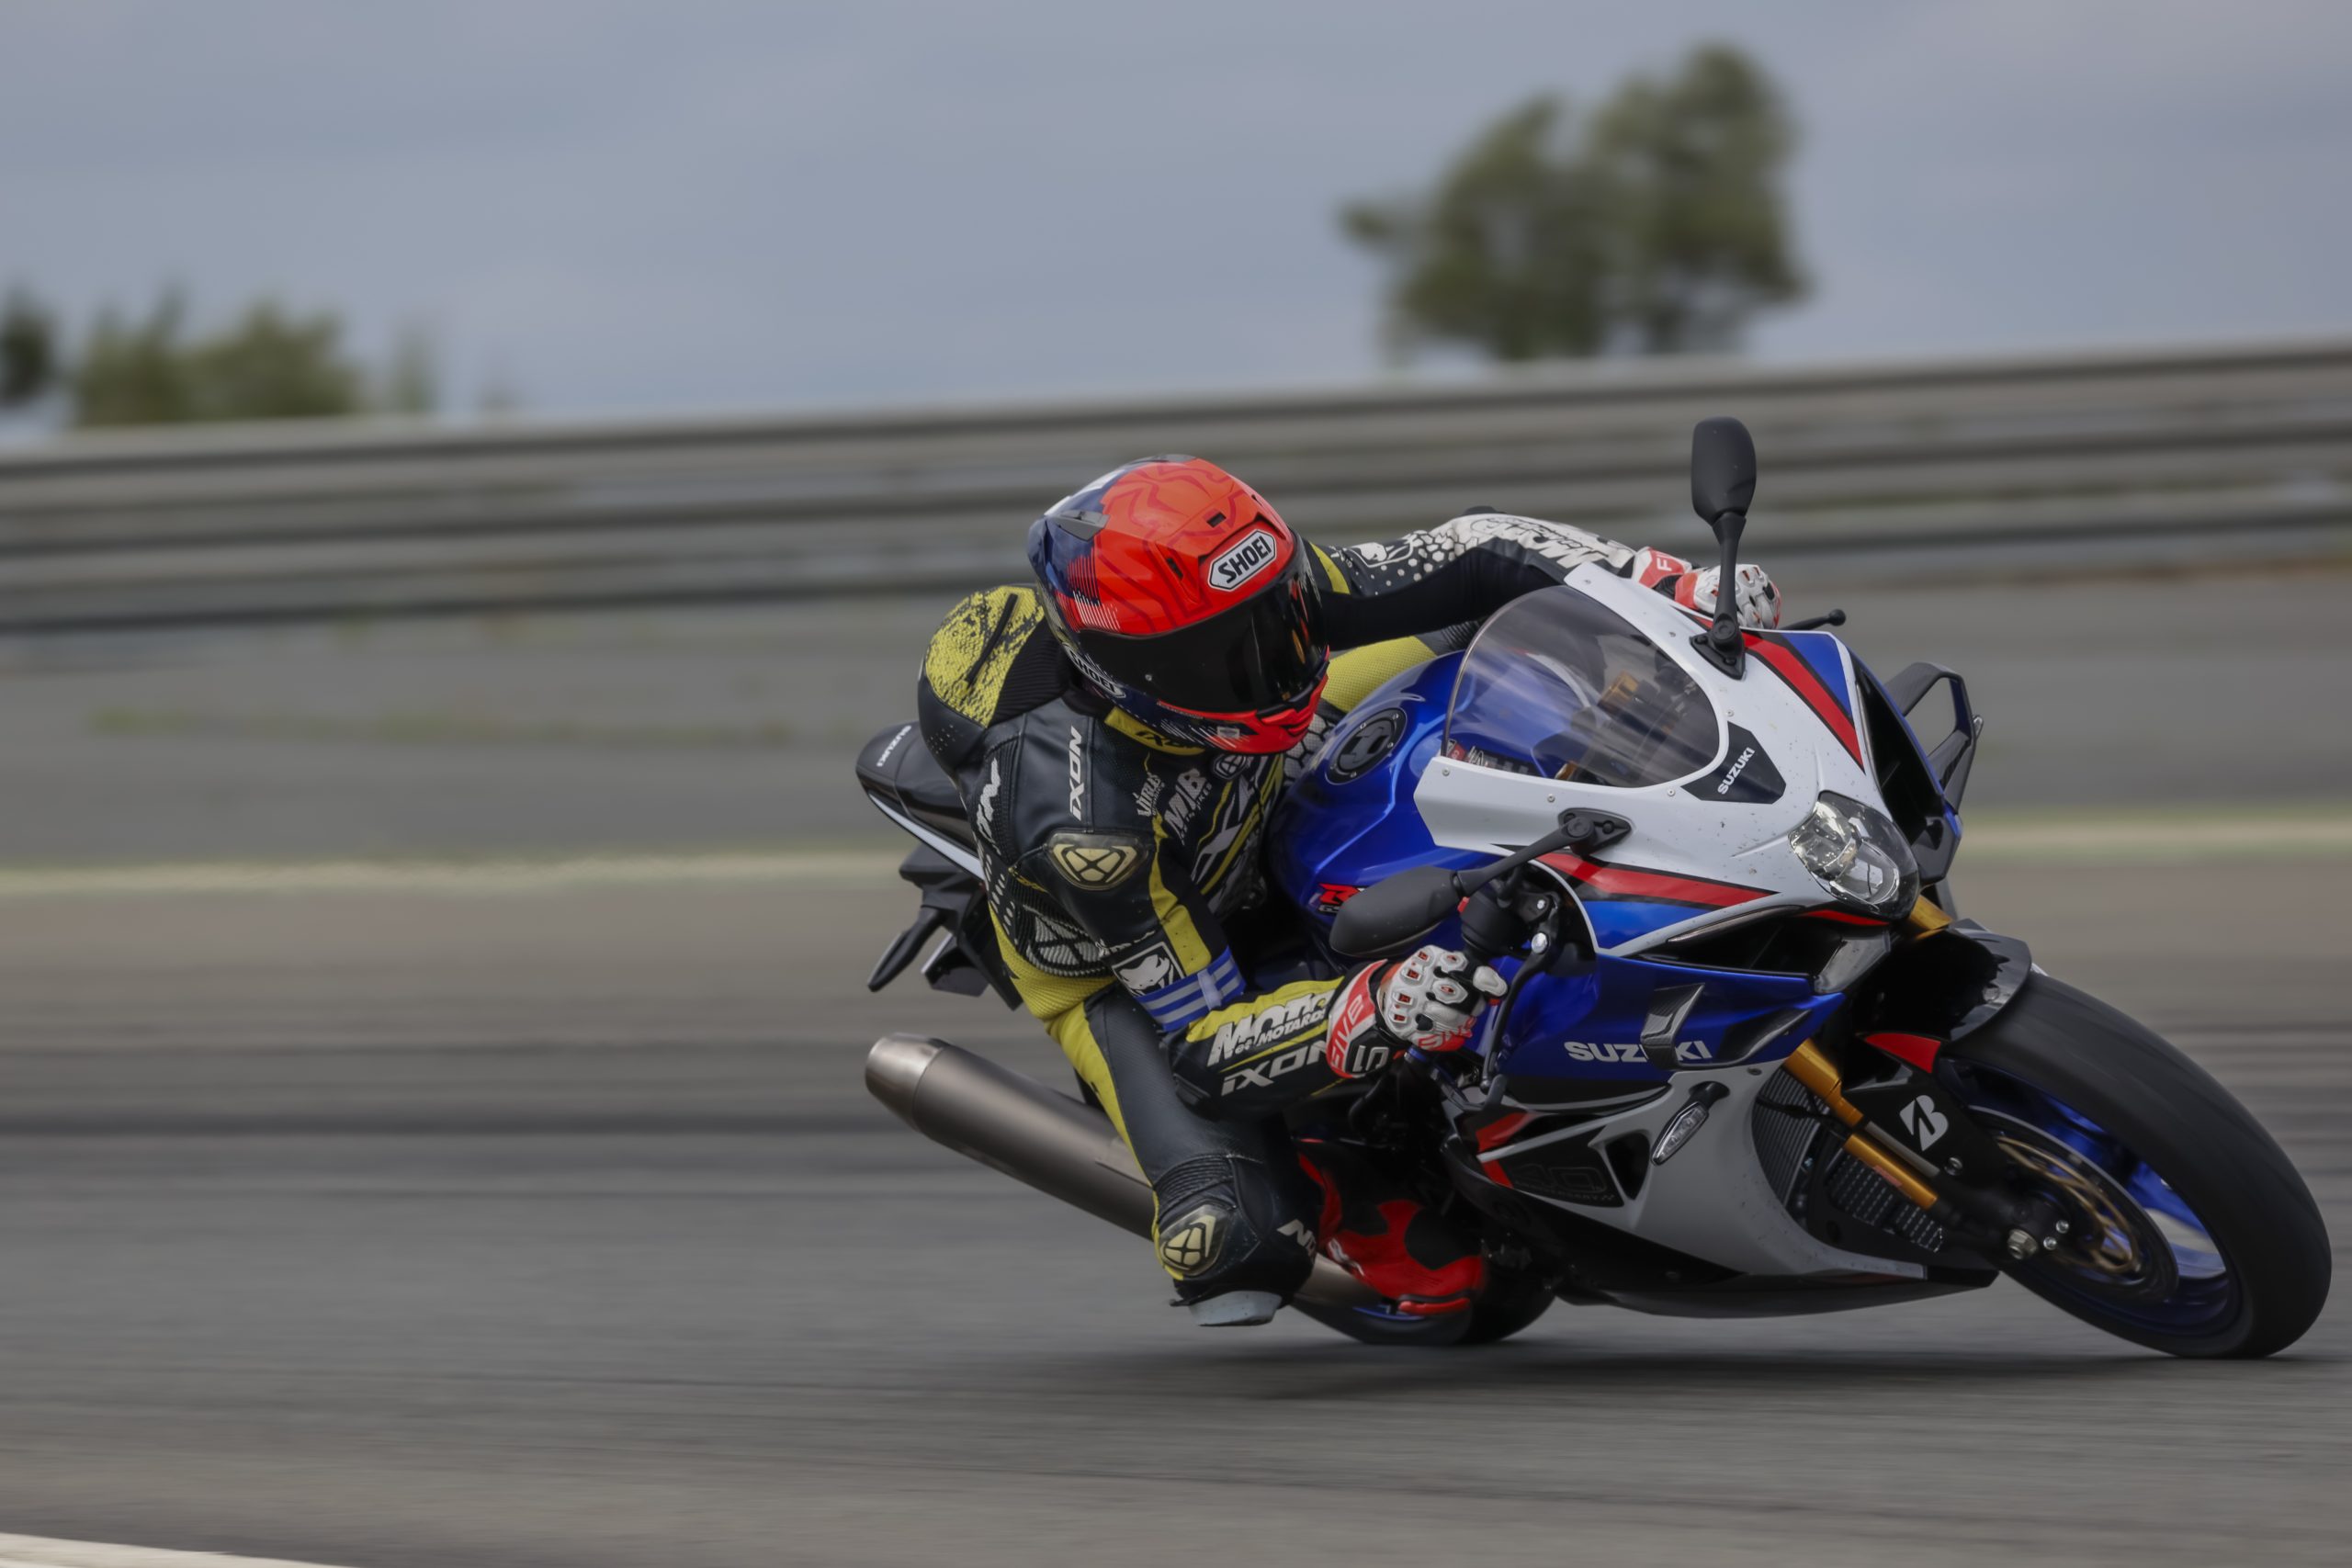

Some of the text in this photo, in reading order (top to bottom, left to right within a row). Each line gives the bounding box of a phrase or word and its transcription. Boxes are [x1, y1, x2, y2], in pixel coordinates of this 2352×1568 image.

[1217, 536, 1272, 584] SHOEI
[876, 725, 912, 768] SUZUKI
[1717, 746, 1756, 795] SUZUKI
[1332, 993, 1365, 1072] FIVE
[1564, 1041, 1713, 1064] SUZKI
